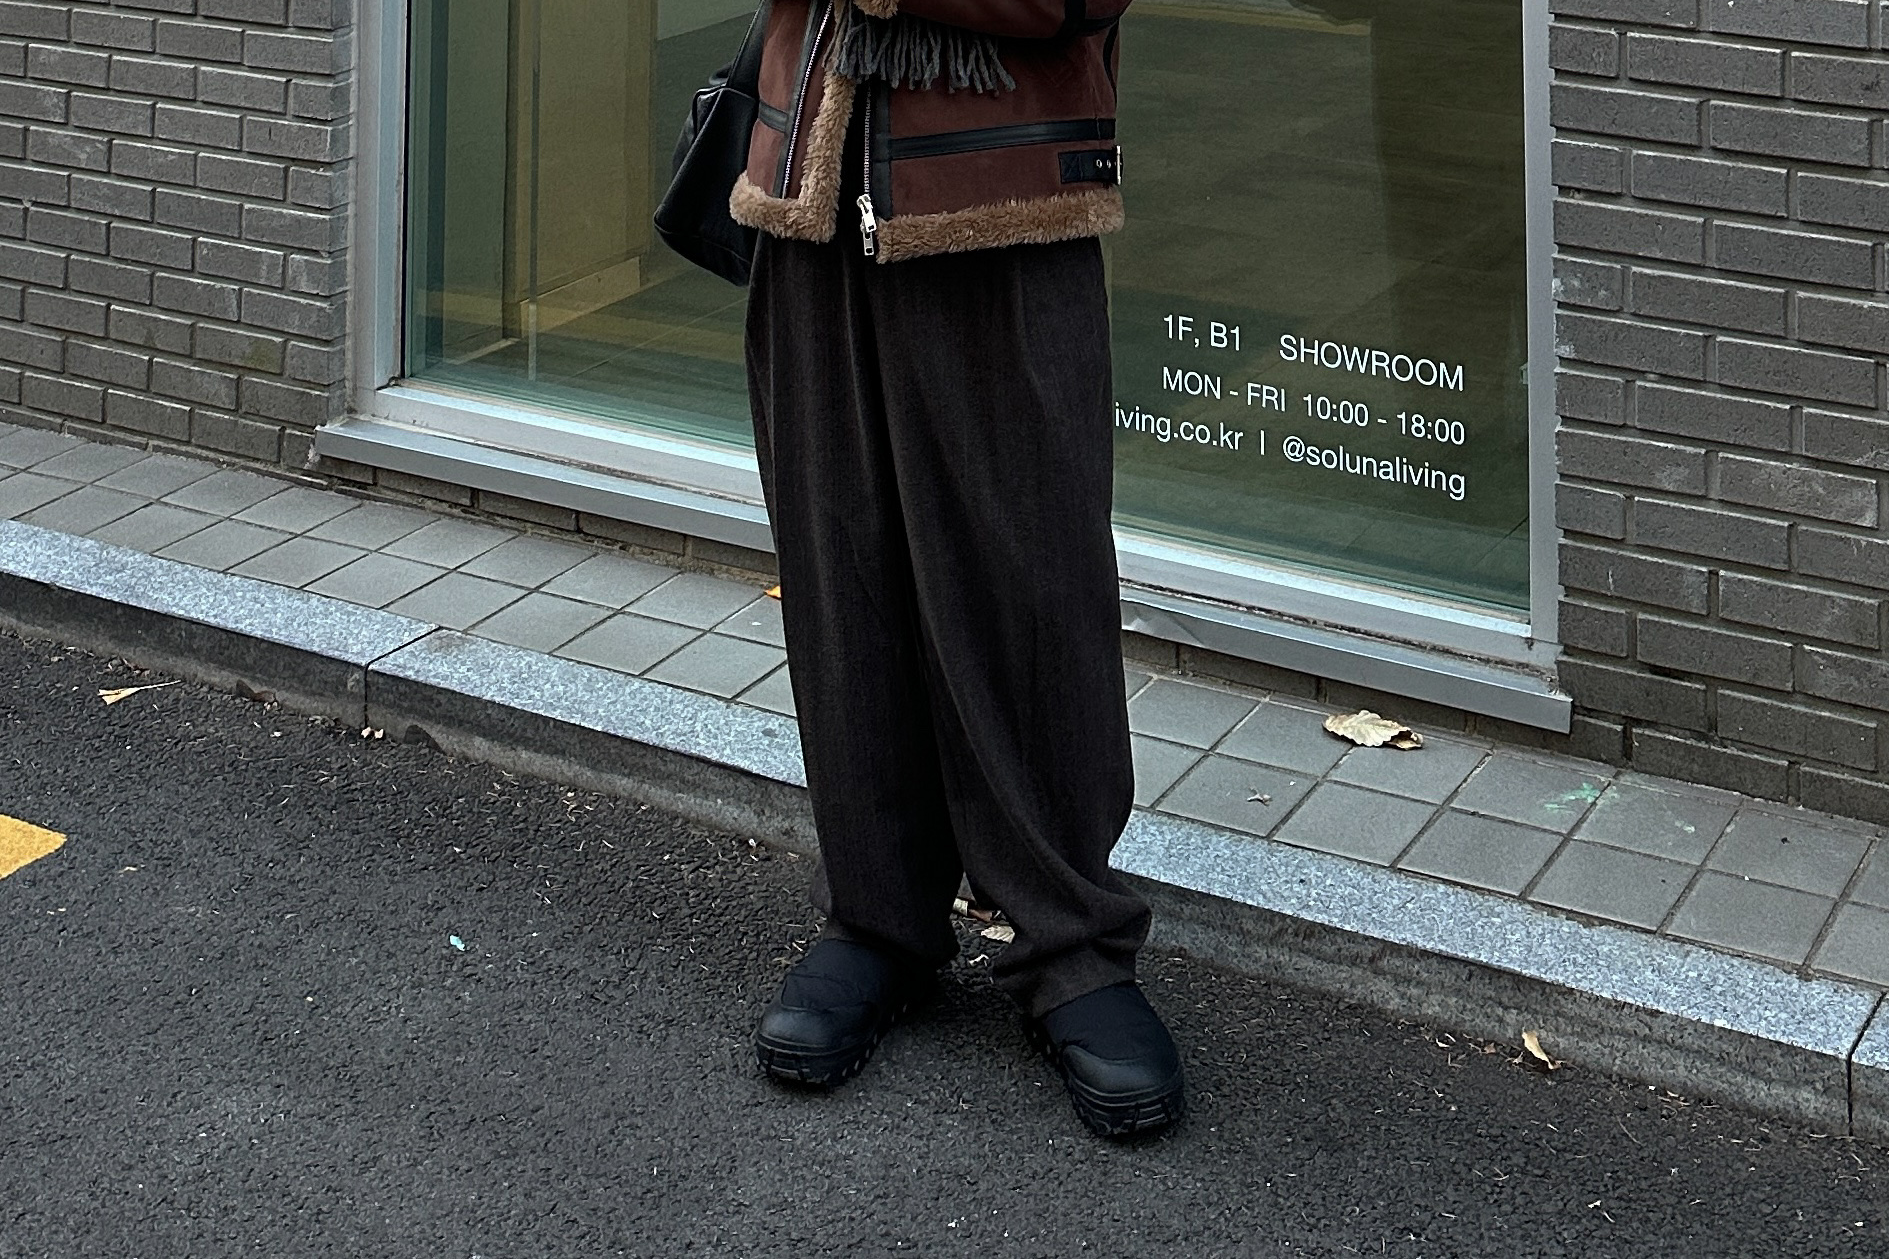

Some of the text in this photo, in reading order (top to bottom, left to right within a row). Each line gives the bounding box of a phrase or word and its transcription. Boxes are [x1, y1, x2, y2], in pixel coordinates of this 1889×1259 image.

[1163, 314, 1464, 392] 1F, B1 SHOWROOM
[1163, 366, 1221, 400] MON
[1247, 382, 1286, 412] FRI
[1302, 393, 1369, 427] 10:00
[1396, 411, 1465, 445] 18:00
[1115, 401, 1244, 451] iving.co.kr
[1282, 435, 1465, 501] @solunaliving
